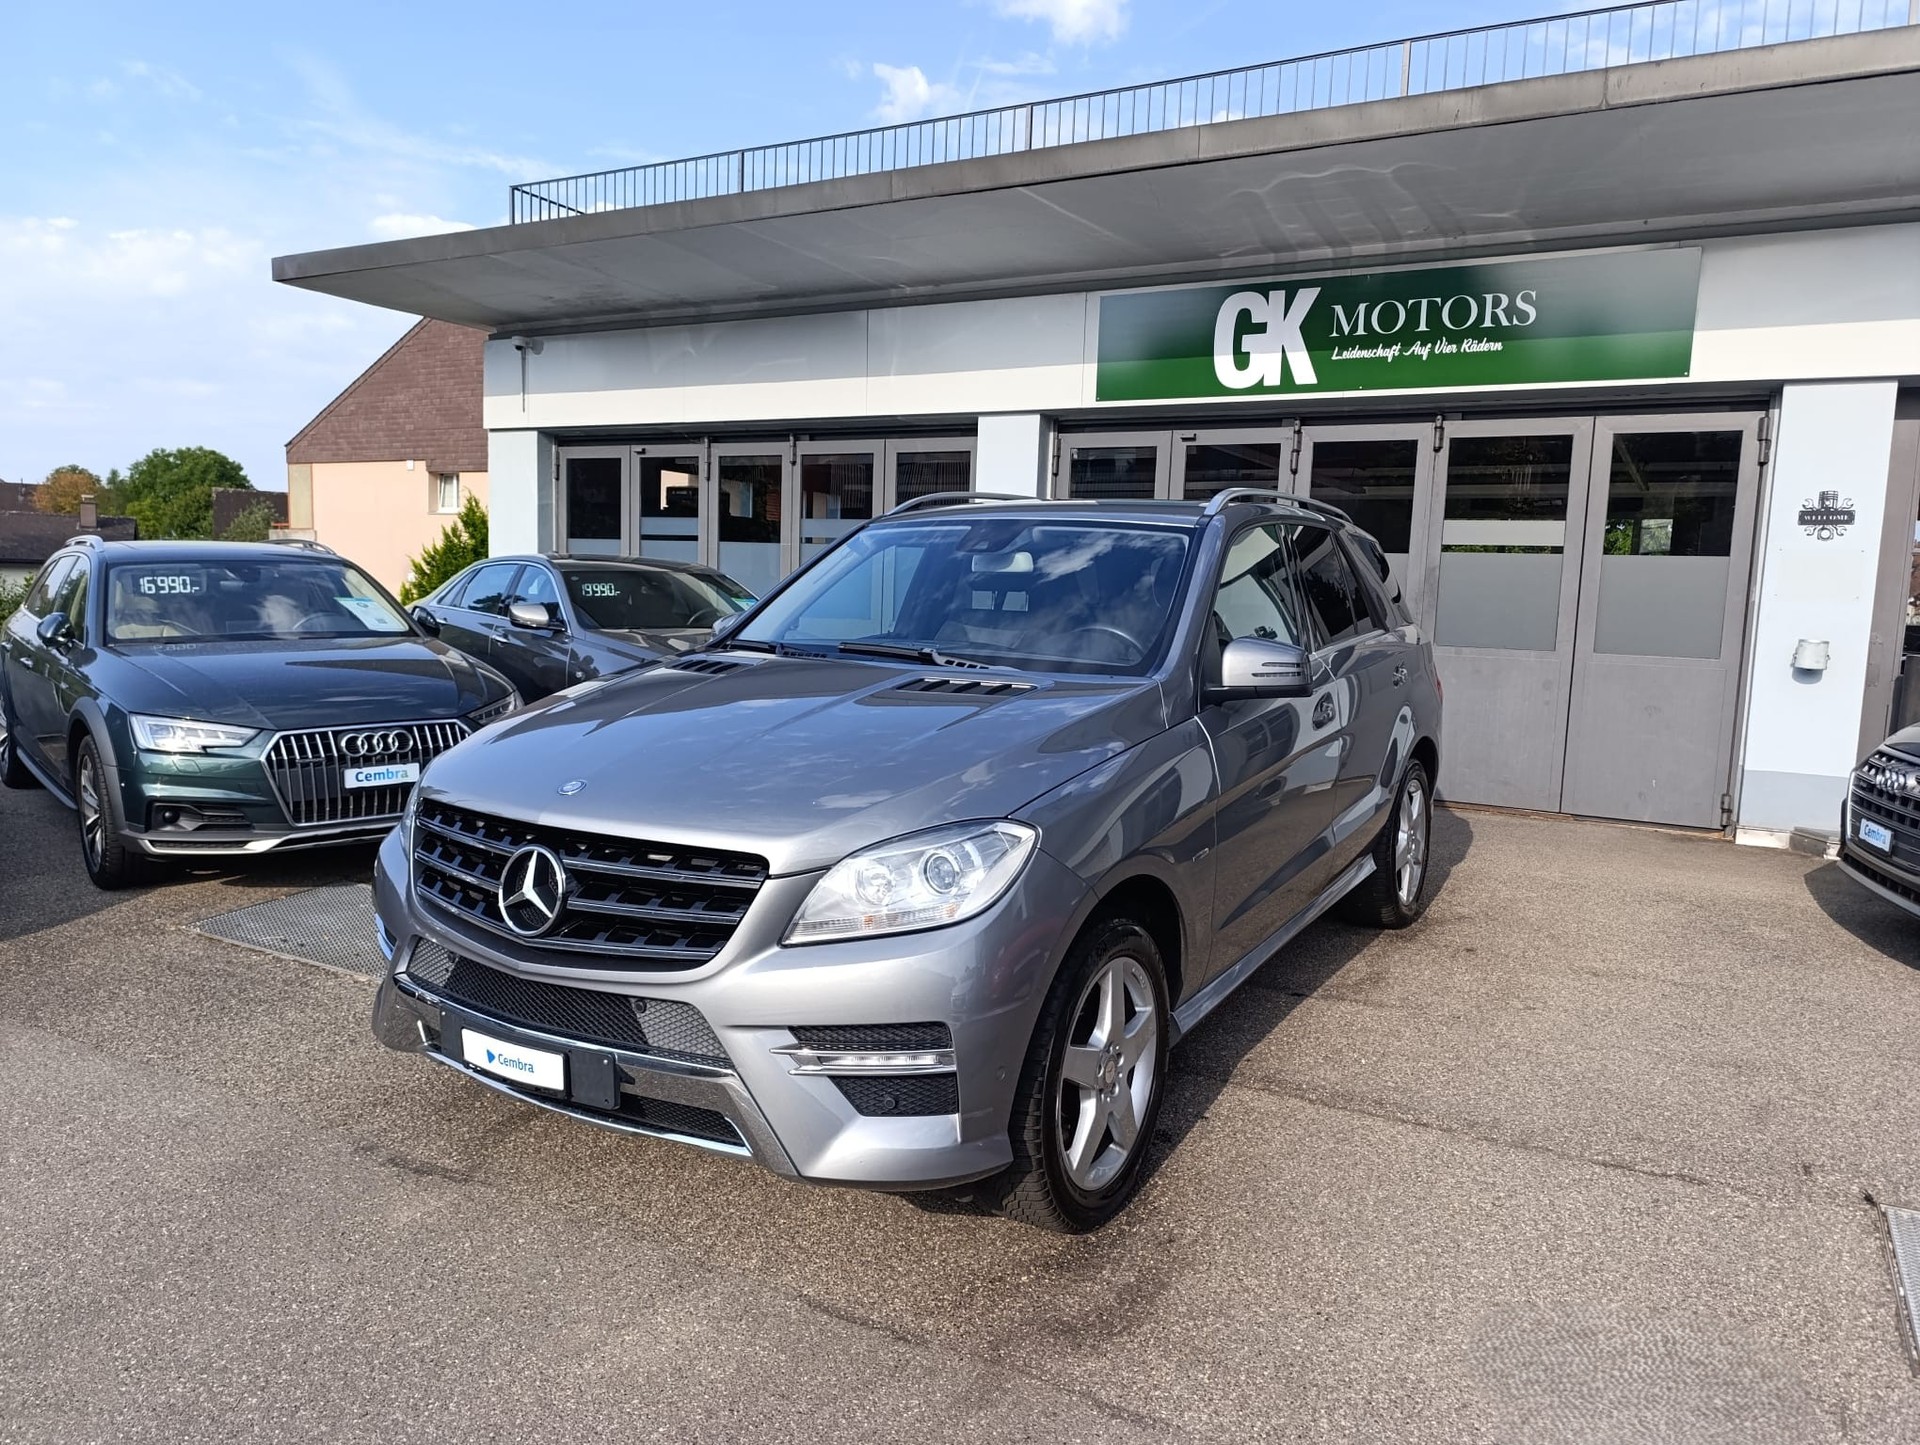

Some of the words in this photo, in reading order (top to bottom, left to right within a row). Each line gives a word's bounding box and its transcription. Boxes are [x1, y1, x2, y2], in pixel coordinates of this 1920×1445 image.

[1213, 287, 1321, 389] GK
[1329, 290, 1537, 337] MOTORS
[1331, 342, 1400, 363] Leidenschaft
[1402, 340, 1431, 360] Auf
[1434, 337, 1458, 355] Vier
[1460, 337, 1503, 354] Rädern
[355, 768, 409, 782] Cembra
[1864, 823, 1887, 845] Cembra
[498, 1053, 535, 1074] Cembra
